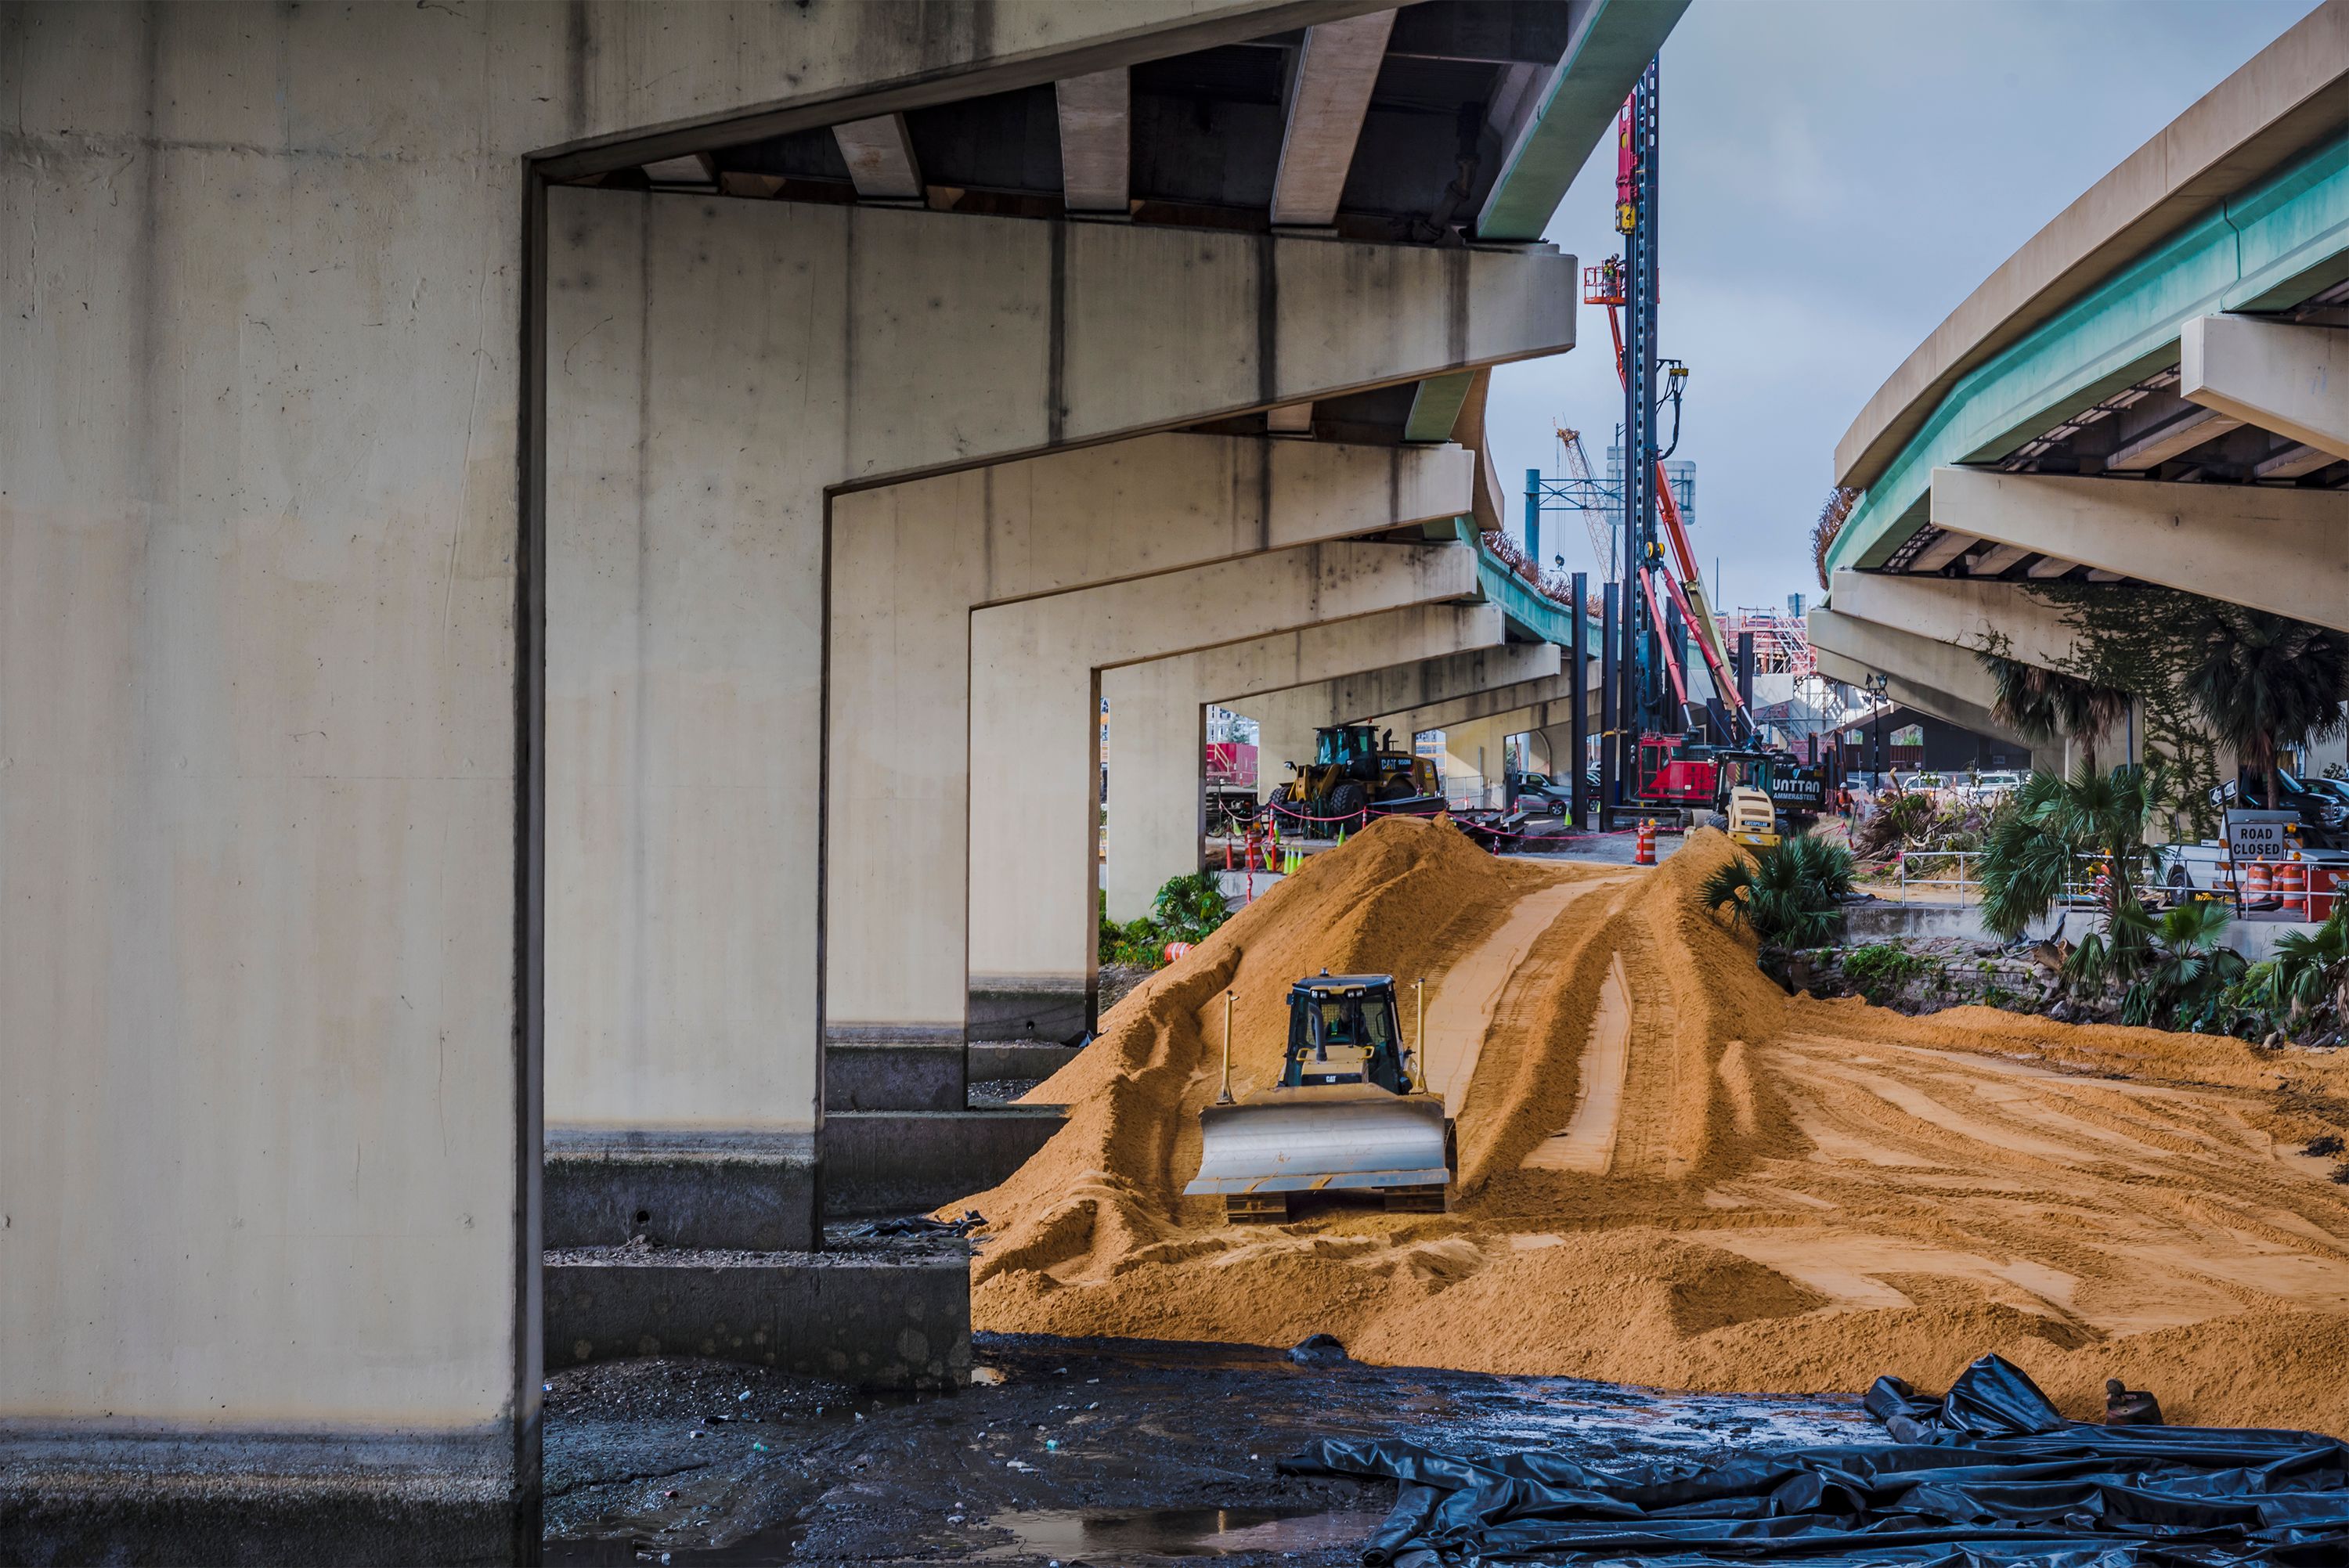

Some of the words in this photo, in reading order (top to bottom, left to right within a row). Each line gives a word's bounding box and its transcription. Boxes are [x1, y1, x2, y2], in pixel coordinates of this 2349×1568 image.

[1381, 759, 1396, 770] CAT
[1773, 779, 1820, 792] UNTTAN
[2241, 828, 2272, 839] ROAD
[2234, 843, 2279, 855] CLOSED
